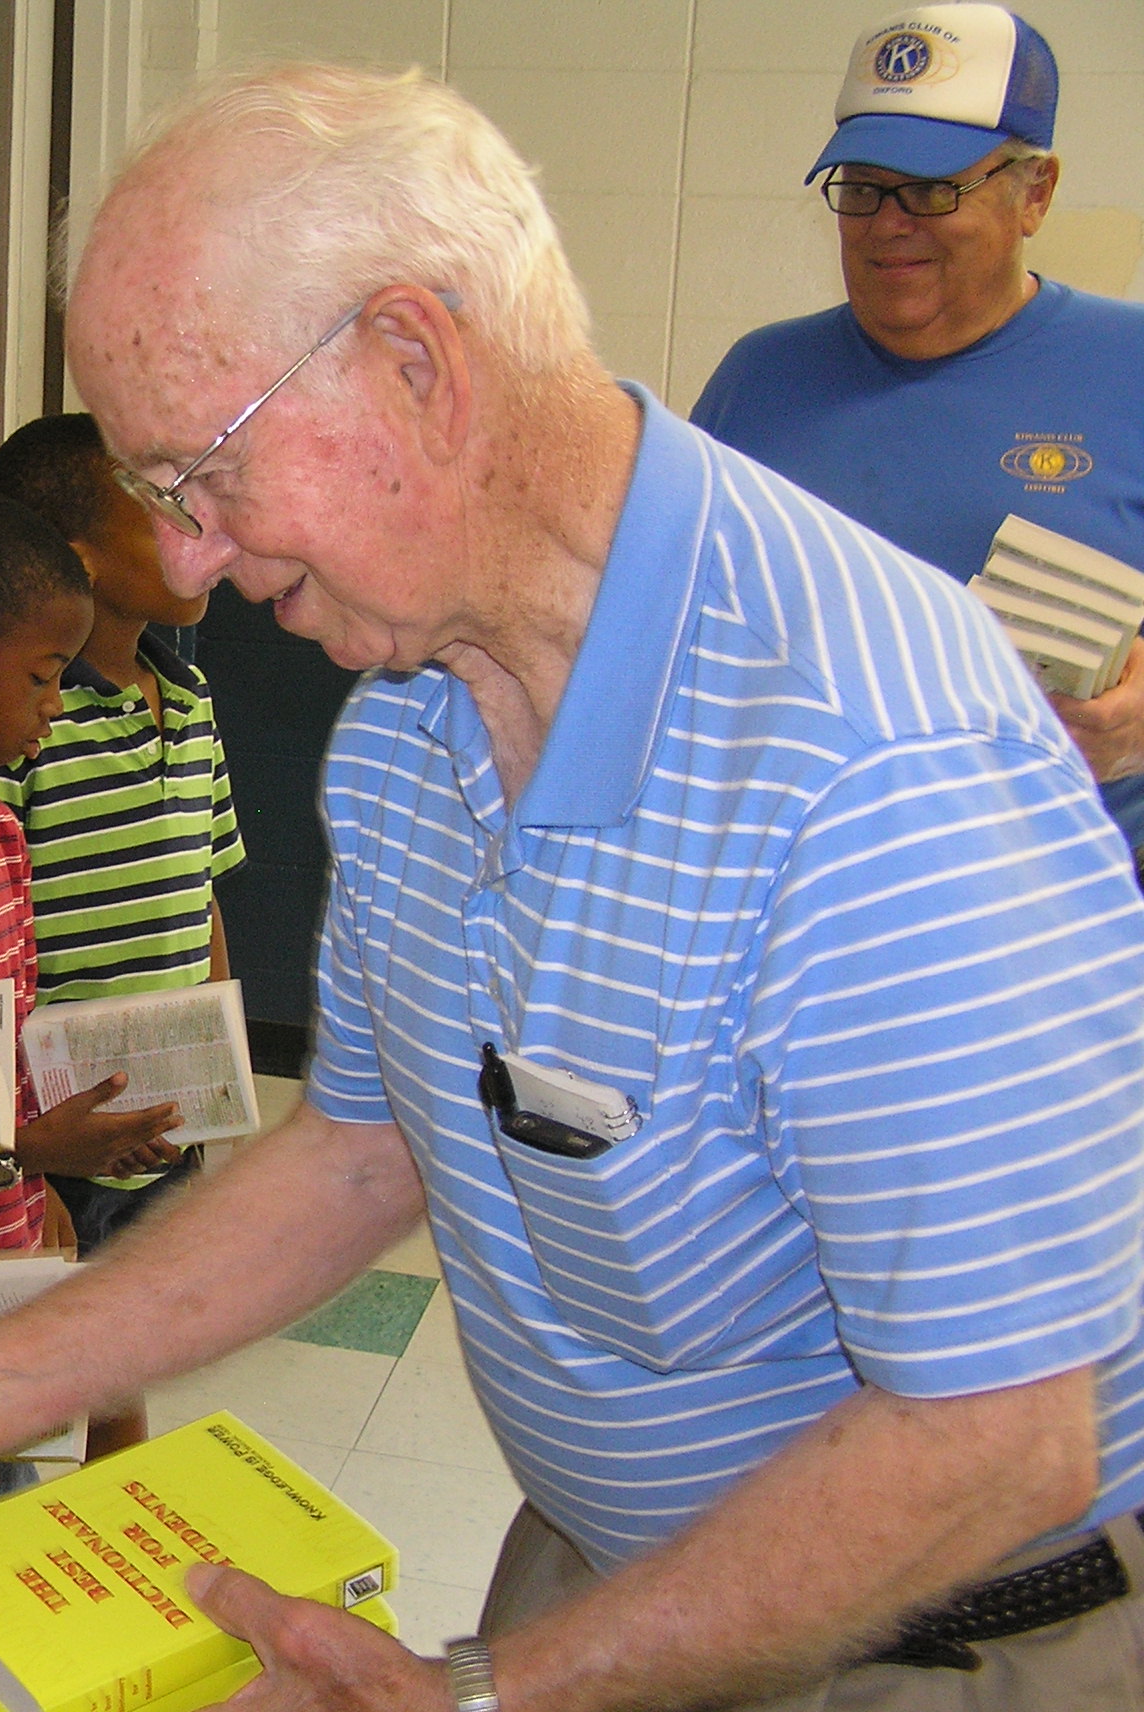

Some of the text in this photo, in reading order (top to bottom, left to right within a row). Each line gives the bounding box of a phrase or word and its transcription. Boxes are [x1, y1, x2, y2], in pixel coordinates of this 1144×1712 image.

[908, 22, 942, 36] CLUB
[943, 32, 961, 44] OF
[886, 43, 916, 75] K
[872, 86, 913, 96] OXFORD
[40, 1498, 195, 1630] DICTIONARY
[121, 1520, 182, 1570] FOR
[14, 1563, 72, 1615] THE
[43, 1547, 116, 1605] BEST
